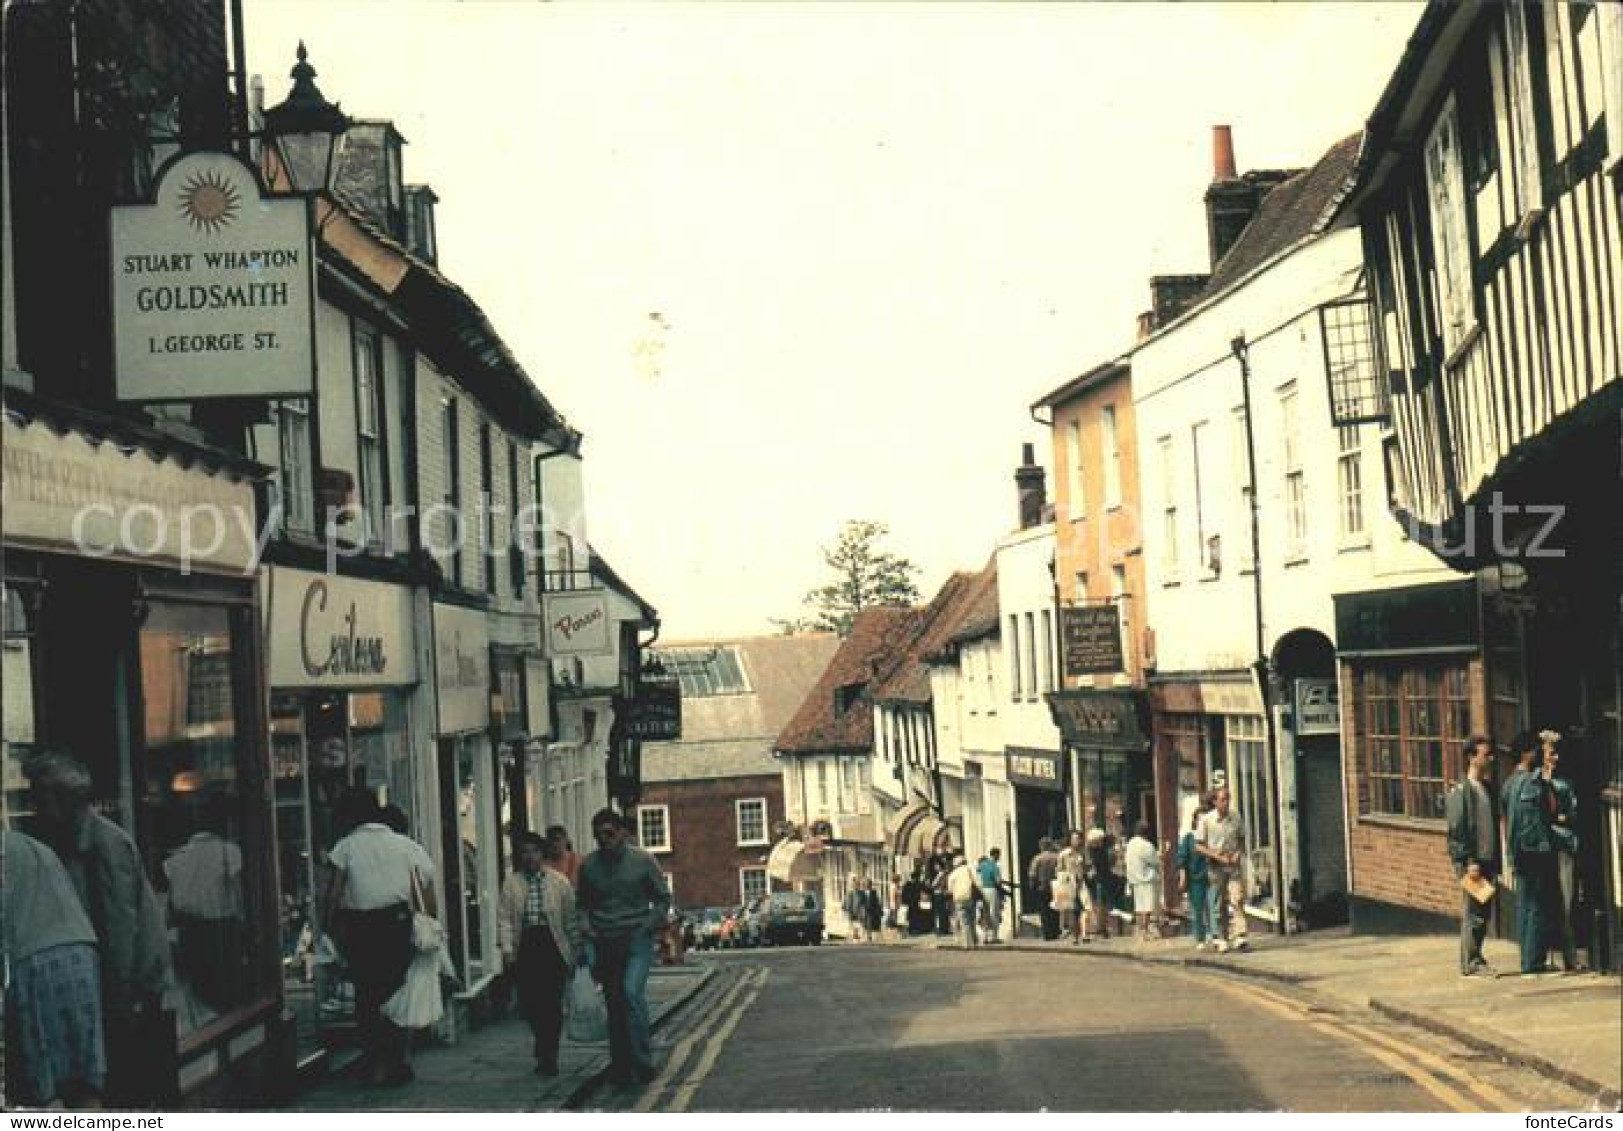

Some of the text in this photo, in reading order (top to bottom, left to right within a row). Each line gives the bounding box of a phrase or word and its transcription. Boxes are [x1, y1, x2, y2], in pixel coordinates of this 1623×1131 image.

[124, 254, 195, 274] STUART
[136, 282, 288, 312] GOLDSMITH
[254, 331, 280, 349] ST.
